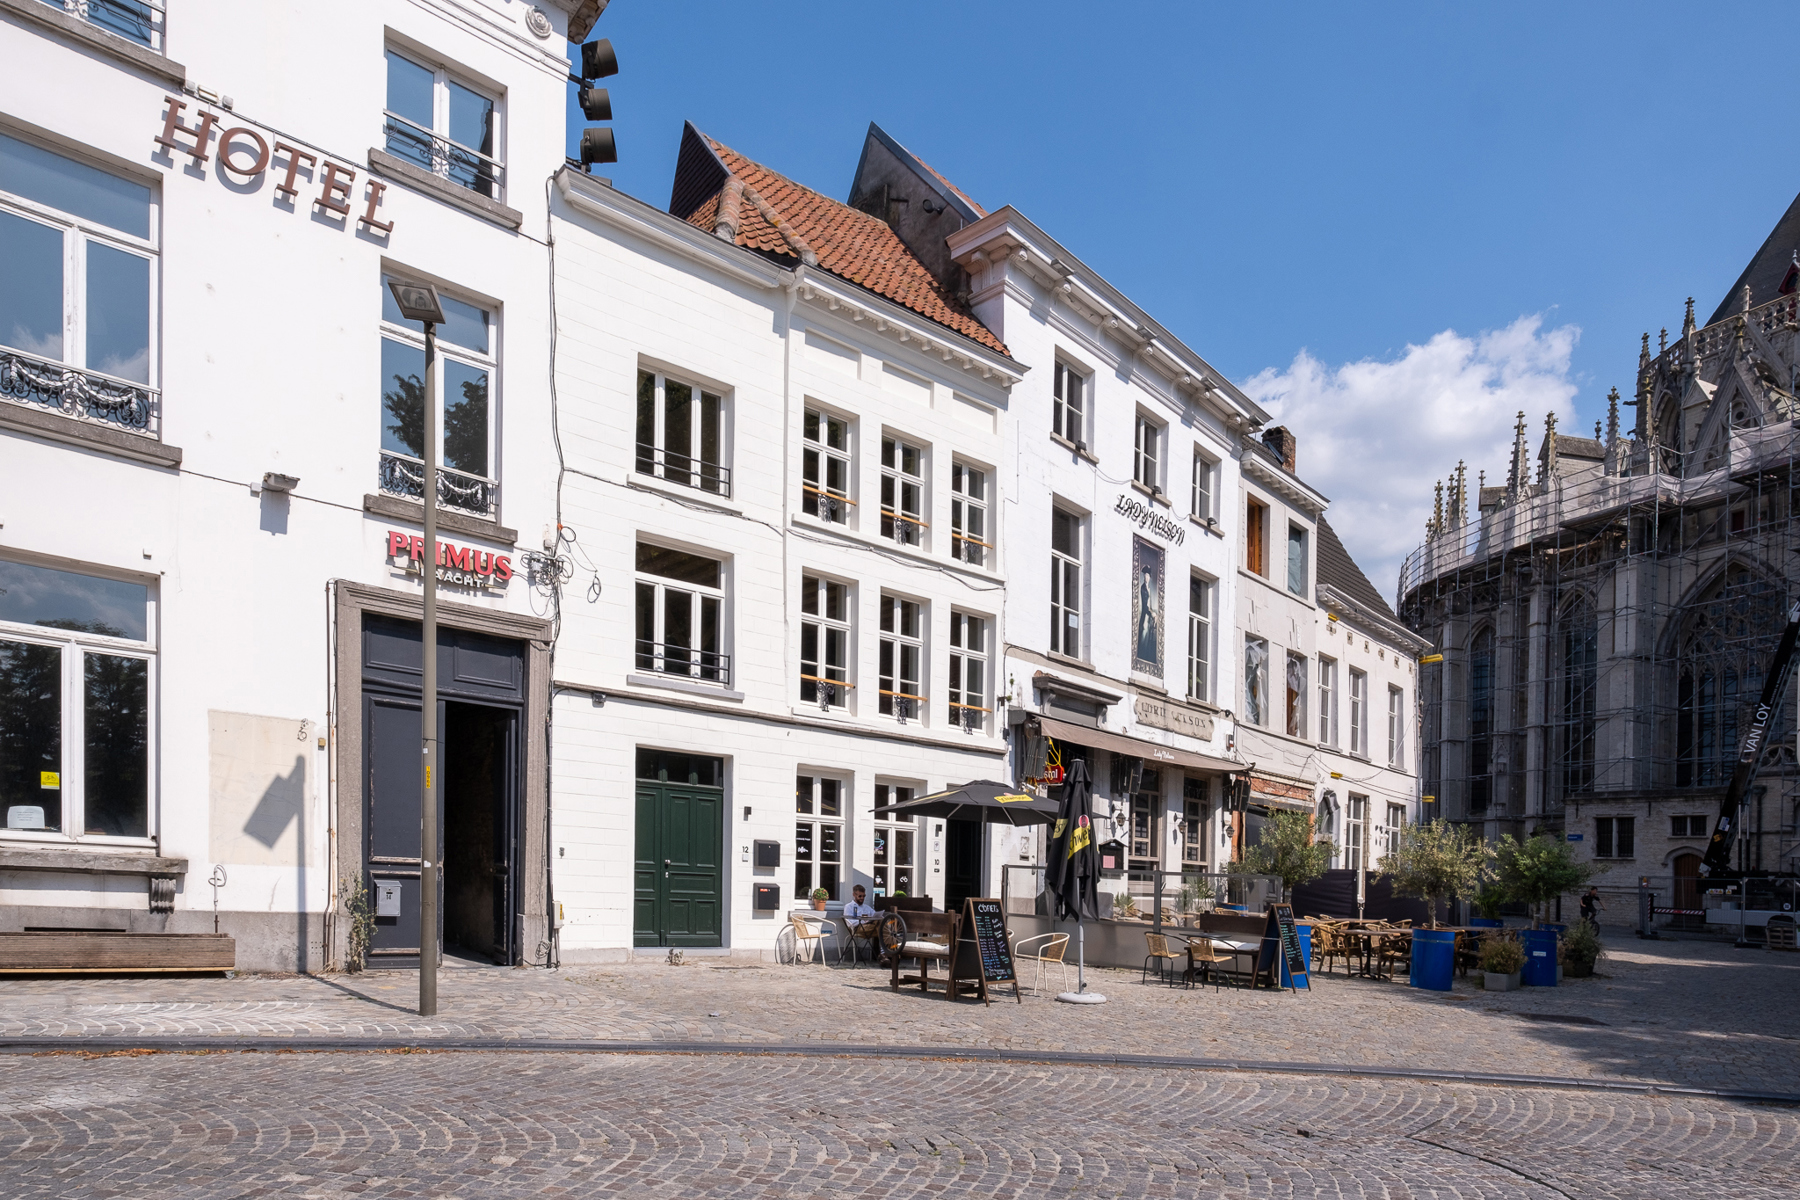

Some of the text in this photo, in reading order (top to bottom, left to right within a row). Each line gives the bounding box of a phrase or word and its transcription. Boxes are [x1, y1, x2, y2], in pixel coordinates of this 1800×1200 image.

[154, 96, 395, 233] HOTEL
[387, 530, 513, 581] PRIMUS
[421, 570, 483, 588] AACHT
[1744, 702, 1771, 753] VAN LOY
